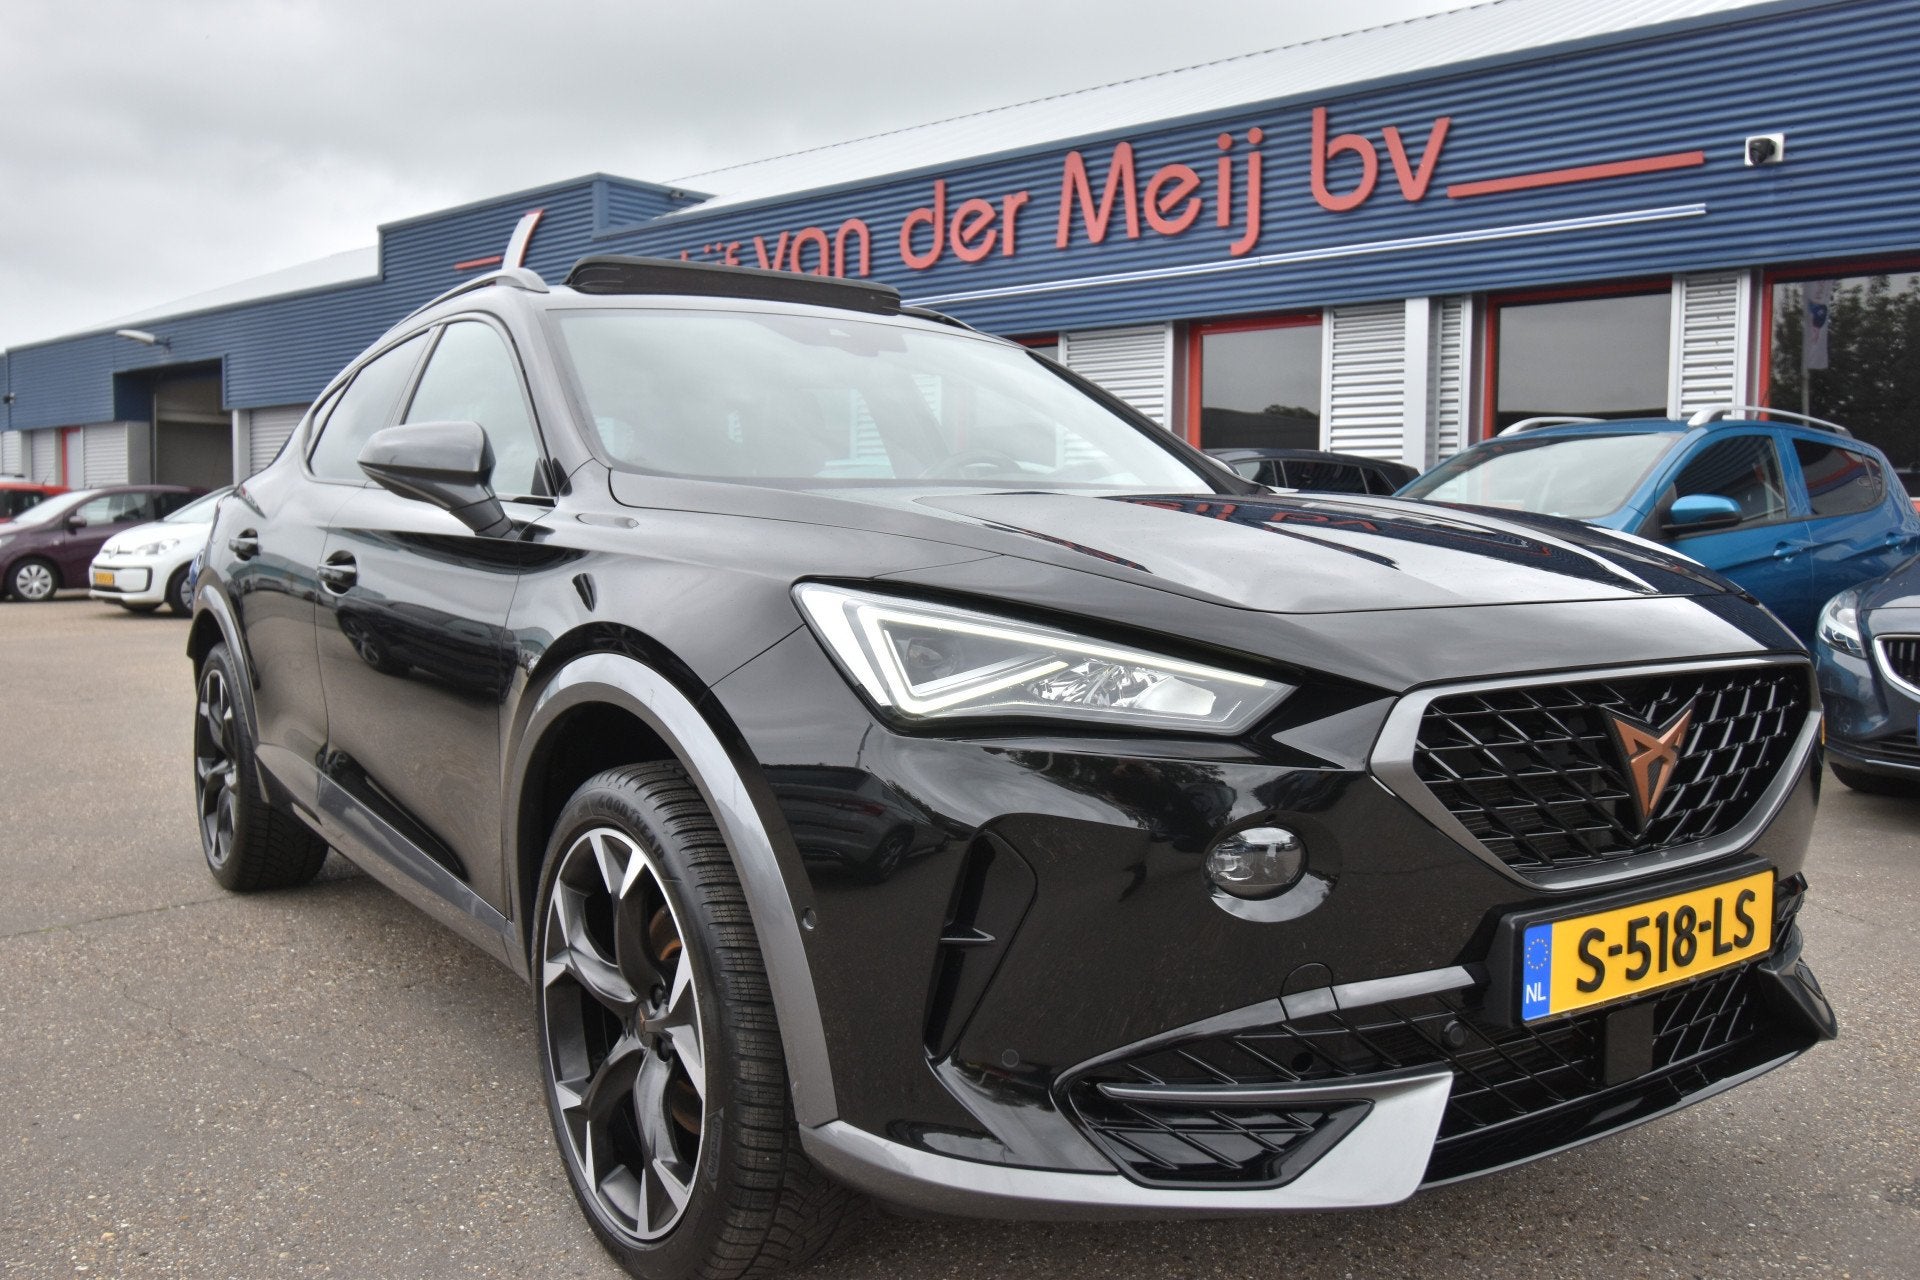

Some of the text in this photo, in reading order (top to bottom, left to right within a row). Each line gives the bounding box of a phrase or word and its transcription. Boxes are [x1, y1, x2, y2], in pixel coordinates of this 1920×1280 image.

[753, 107, 1451, 279] van der Meij bv
[1525, 981, 1546, 1004] NL
[1576, 888, 1756, 993] S-518-LS
